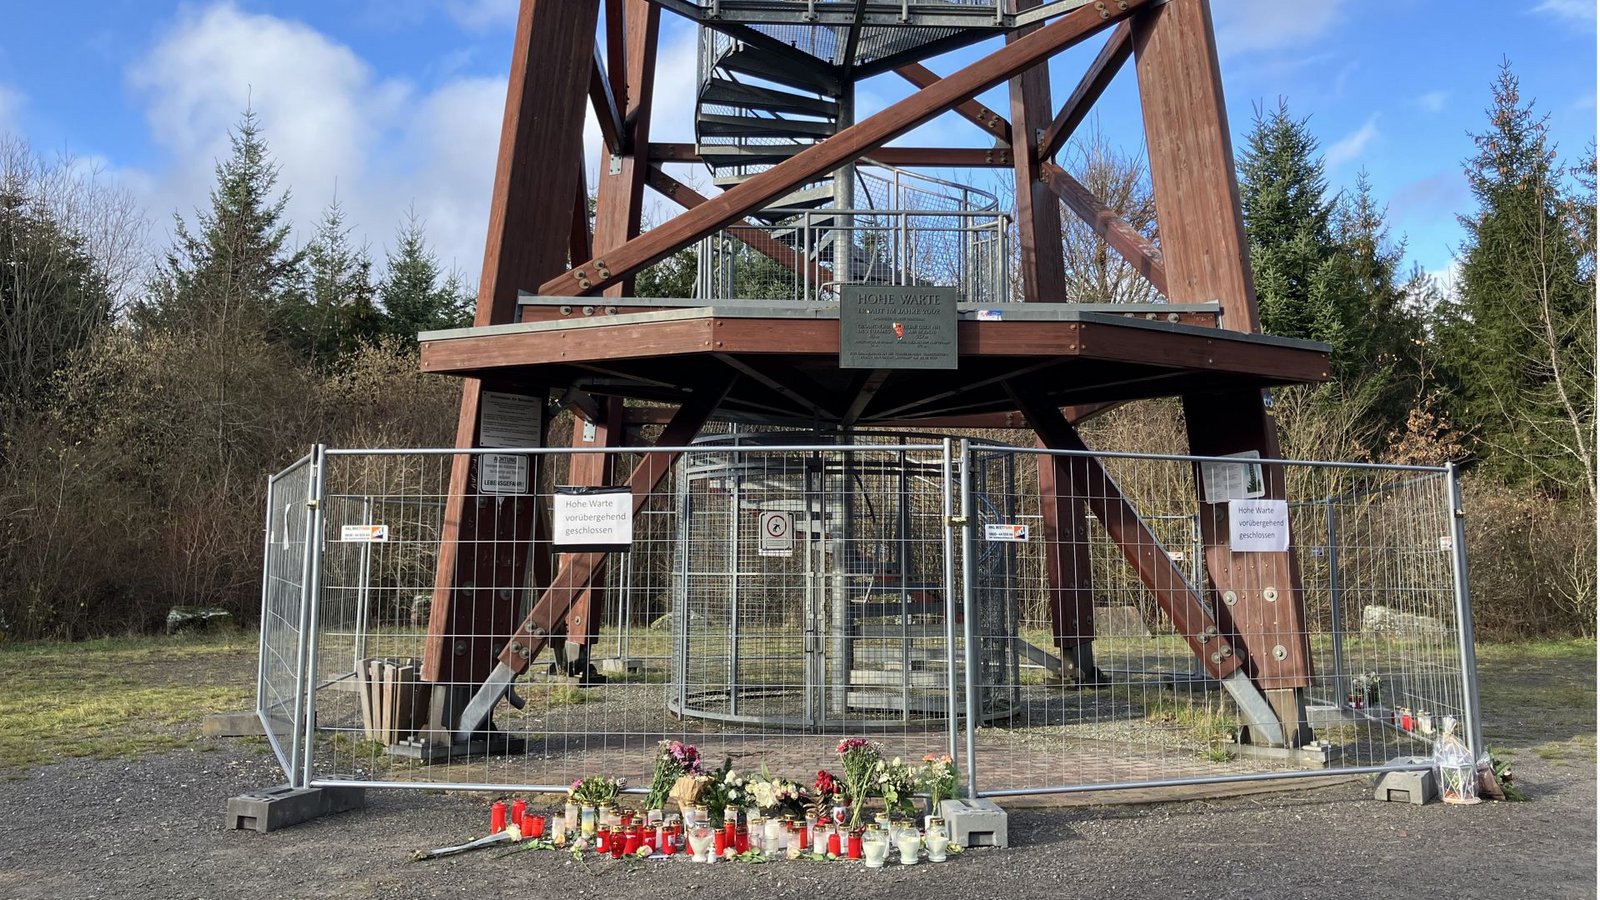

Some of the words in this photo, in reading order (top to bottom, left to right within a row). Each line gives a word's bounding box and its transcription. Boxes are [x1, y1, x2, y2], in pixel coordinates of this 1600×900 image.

[858, 294, 895, 305] HOHE
[900, 294, 941, 305] WARTE
[565, 500, 587, 508] Hohe
[589, 500, 613, 508] Warte
[565, 513, 626, 522] vorübergehend
[1239, 520, 1284, 528] vorübergehend
[565, 526, 613, 536] geschlossen
[1239, 532, 1275, 540] geschlossen
